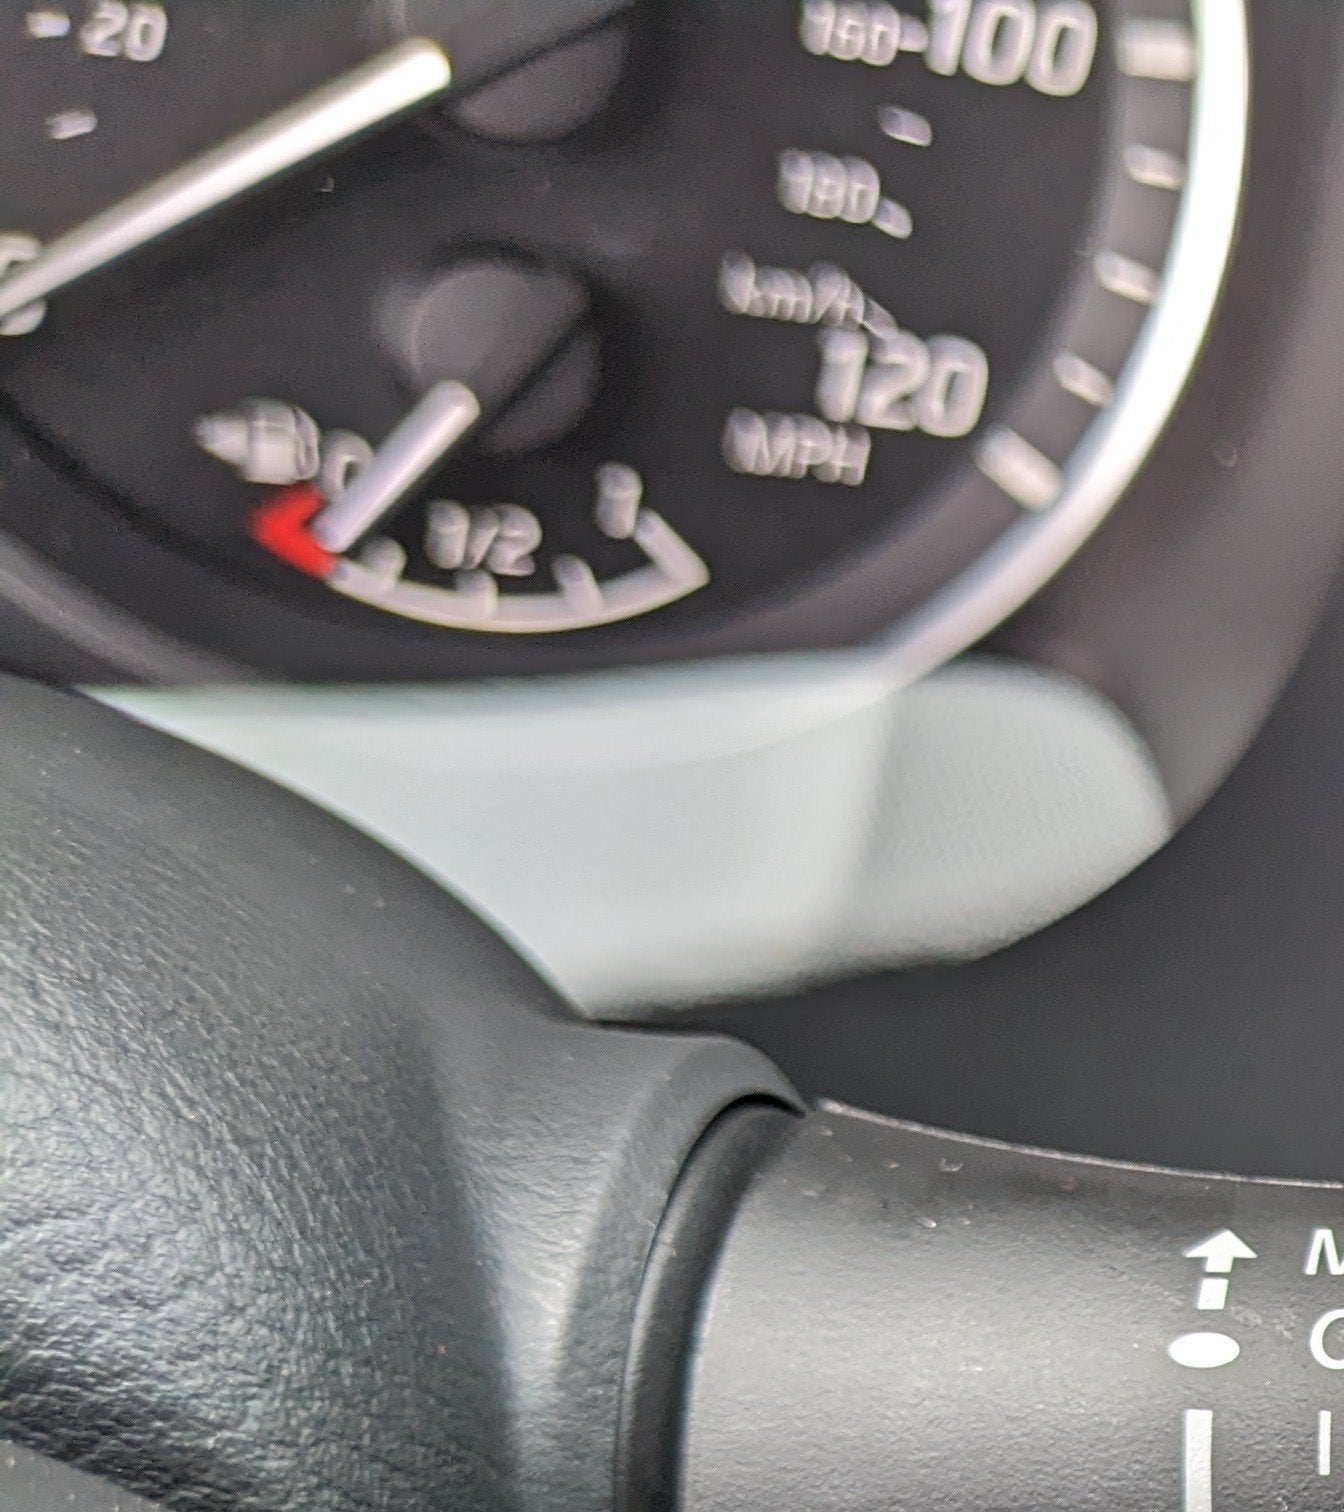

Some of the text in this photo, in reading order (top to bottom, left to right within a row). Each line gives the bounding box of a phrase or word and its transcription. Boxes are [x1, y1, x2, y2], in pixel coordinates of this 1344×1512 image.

[80, 0, 168, 62] 20
[926, 0, 1098, 96] 100
[815, 327, 989, 438] 120
[722, 407, 871, 487] MPH
